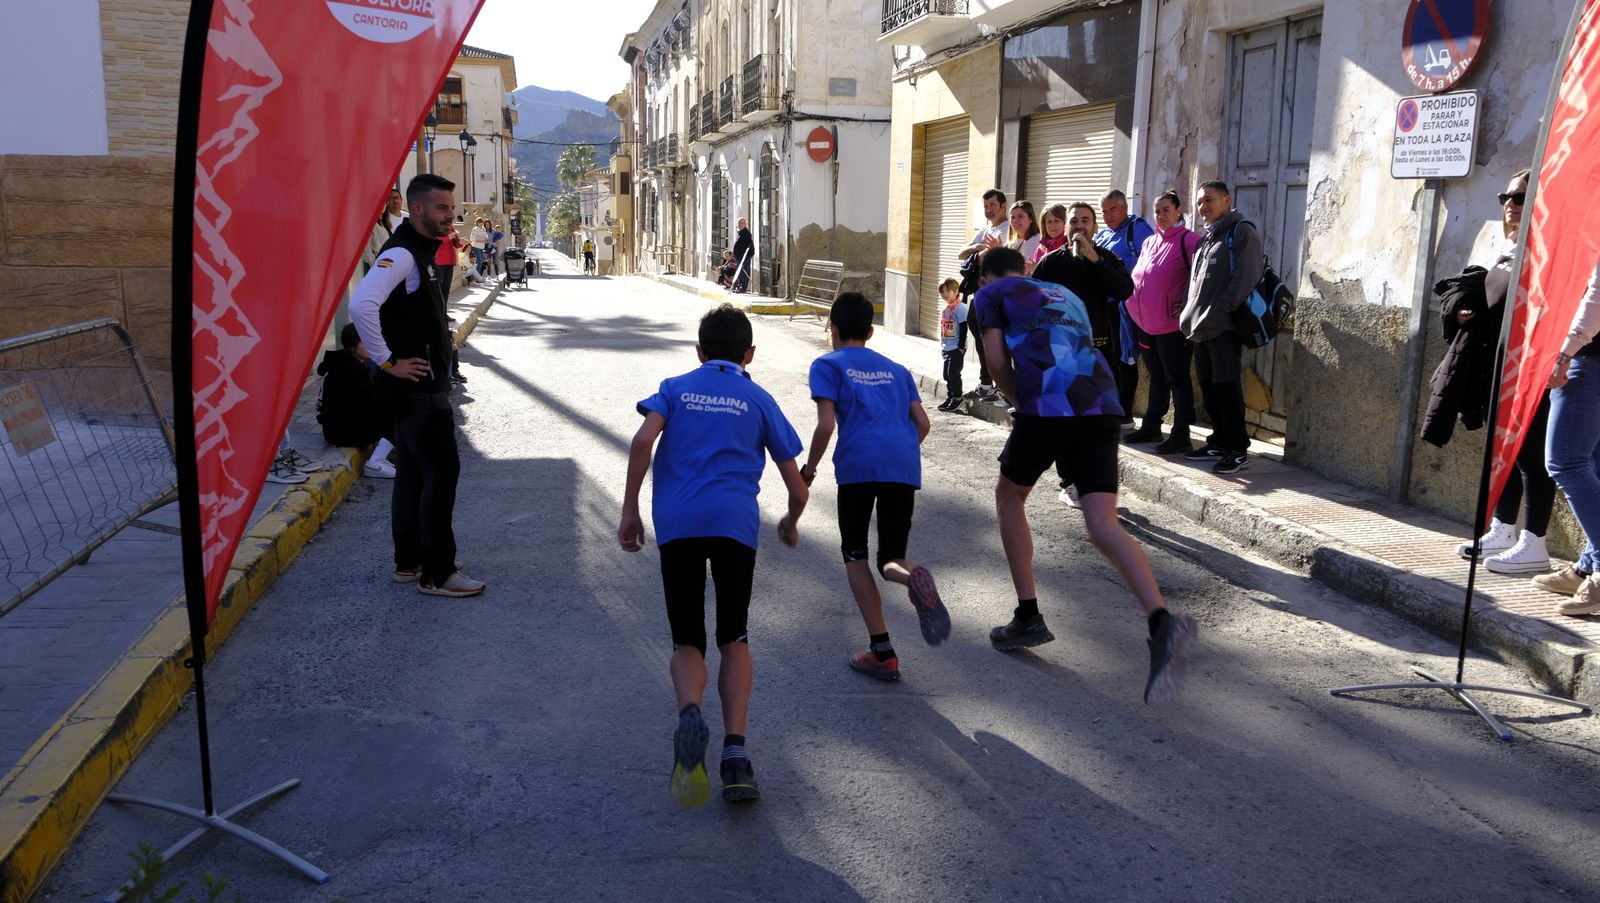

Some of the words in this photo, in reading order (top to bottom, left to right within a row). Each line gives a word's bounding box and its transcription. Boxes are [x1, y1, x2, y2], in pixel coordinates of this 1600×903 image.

[352, 13, 408, 31] CANTORIA
[1408, 64, 1419, 81] de
[1417, 73, 1426, 86] 7
[1437, 79, 1444, 89] a
[1446, 66, 1460, 84] 15
[1421, 95, 1476, 111] PROHIBIDO
[1431, 111, 1456, 121] PARAR
[1457, 110, 1463, 119] Y
[1422, 119, 1470, 131] ESTACIONAR
[1395, 136, 1406, 146] EN
[1407, 135, 1429, 145] TODA
[1431, 134, 1441, 144] LA
[1444, 132, 1472, 143] PLAZA
[1408, 148, 1427, 156] Viernes
[847, 368, 894, 380] GUZMAINA
[852, 377, 863, 385] Club
[680, 392, 749, 412] GUZMAINA
[686, 403, 704, 412] Club
[704, 404, 741, 416] Deportivo
